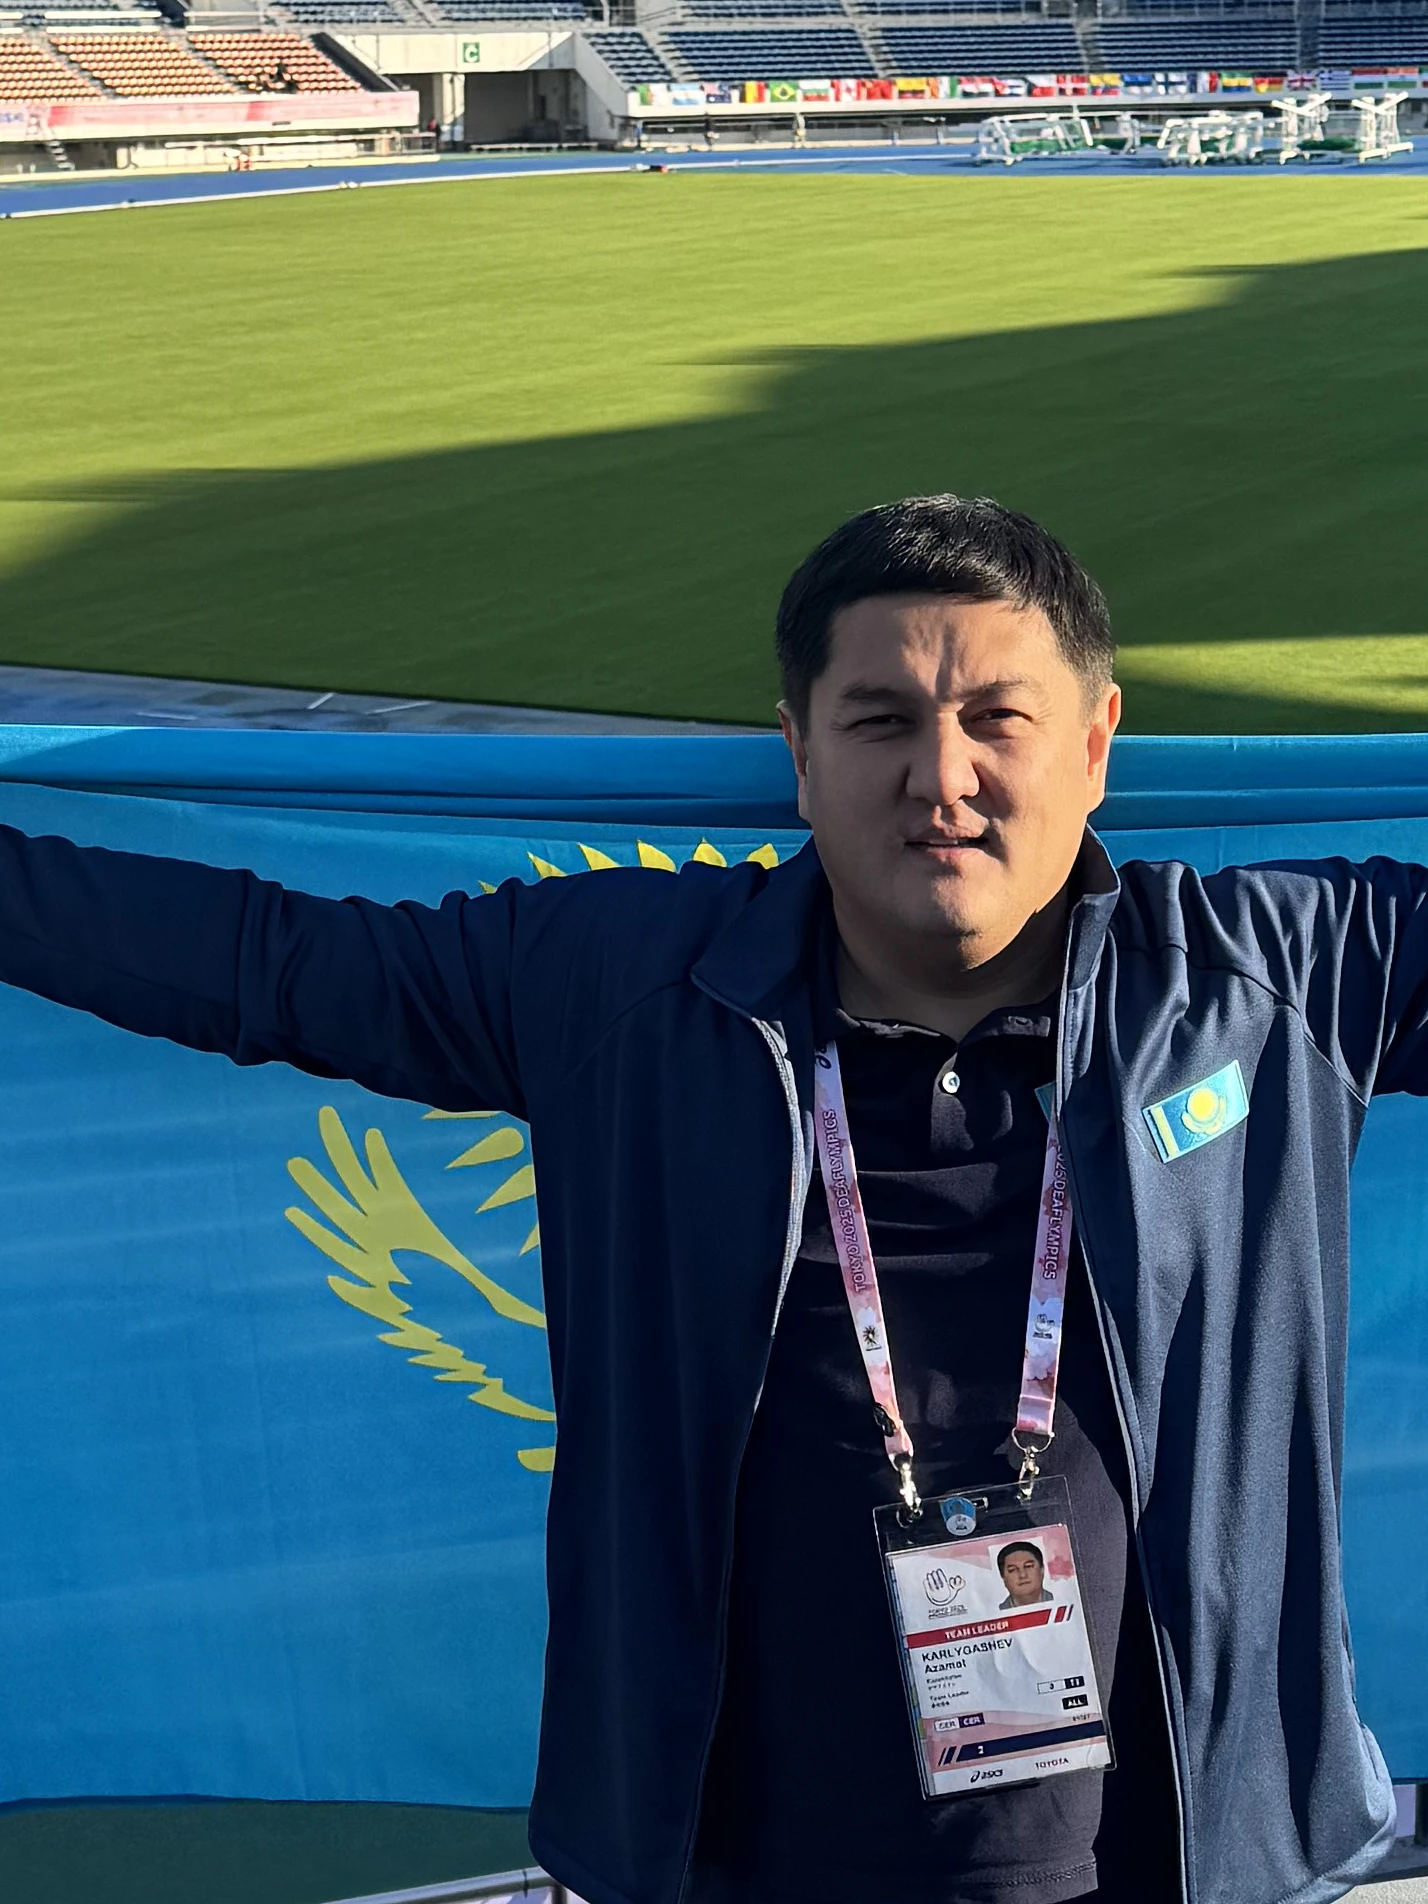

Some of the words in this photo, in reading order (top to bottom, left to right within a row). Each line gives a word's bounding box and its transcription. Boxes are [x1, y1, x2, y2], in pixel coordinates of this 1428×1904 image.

[822, 1108, 852, 1208] DEAFLYMPICS
[839, 1209, 858, 1243] 2025
[1043, 1179, 1066, 1280] DEAFLYMPICS
[848, 1245, 867, 1293] TOKYO
[945, 1627, 971, 1639] TEAM
[972, 1620, 1009, 1635] LEADER
[1035, 1757, 1069, 1771] TOYOTA
